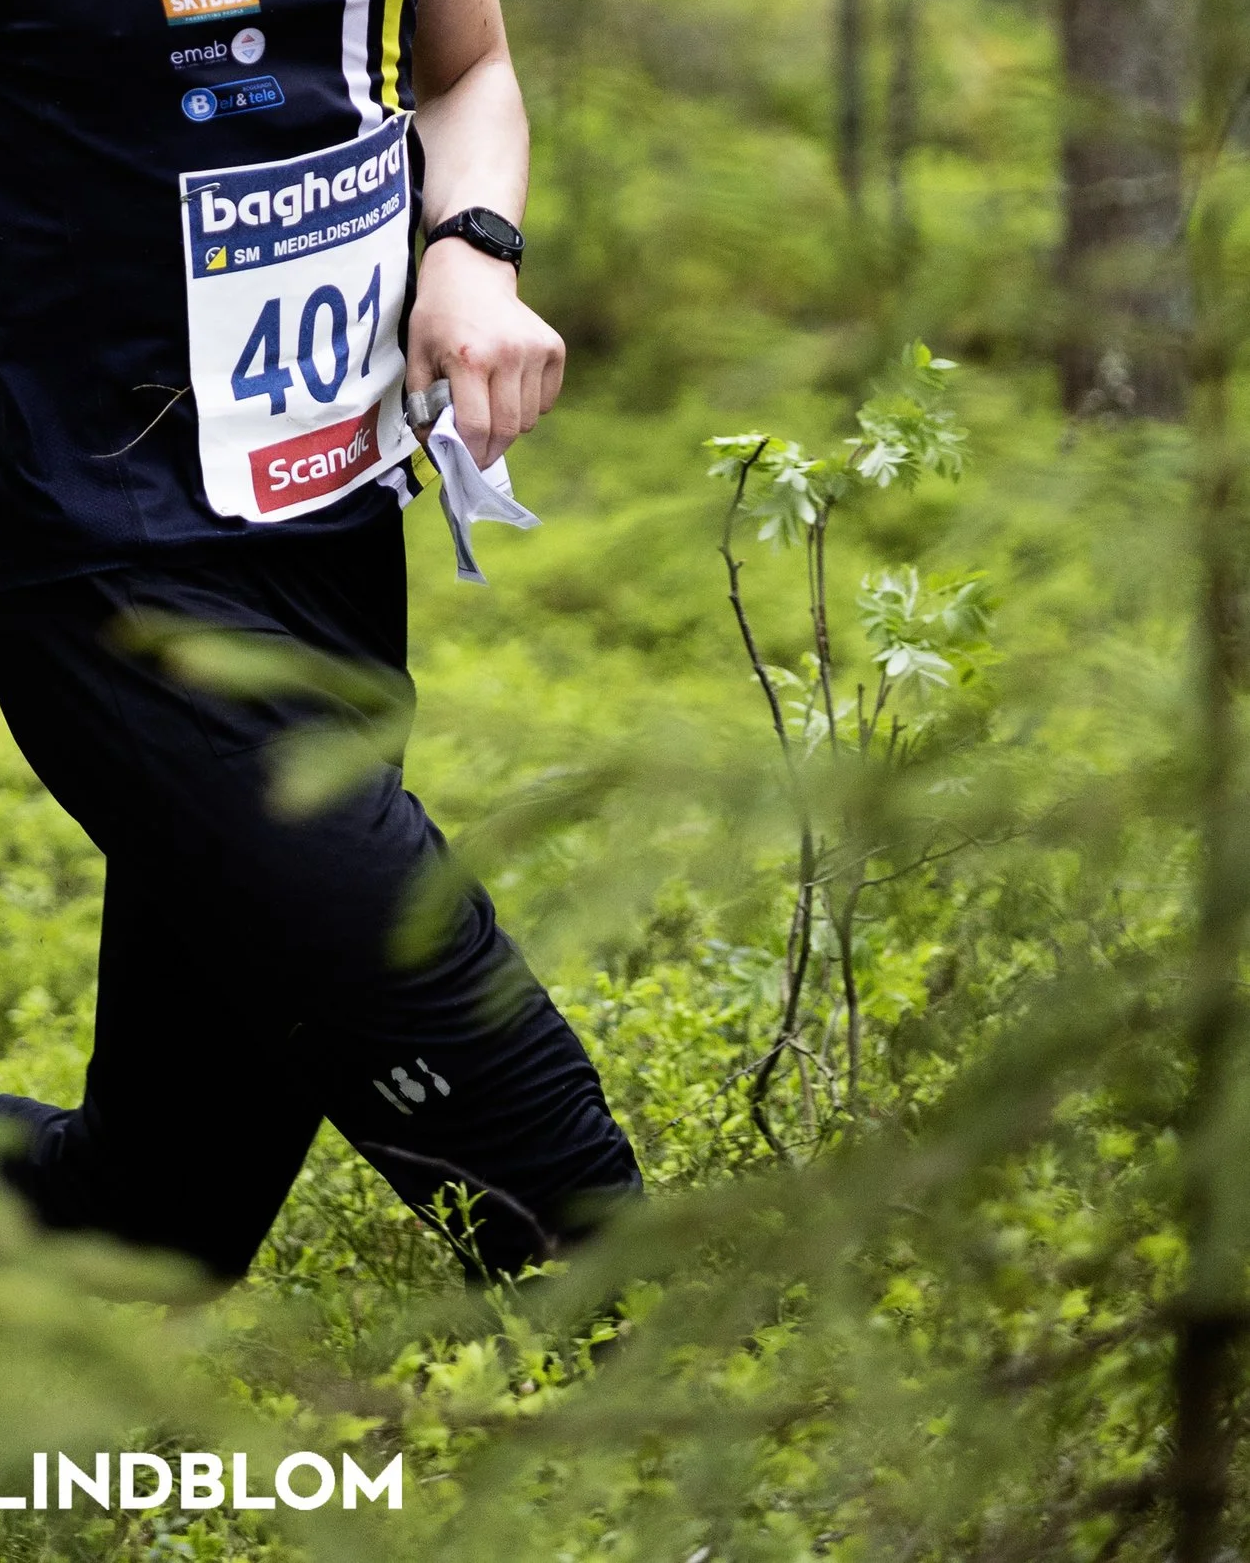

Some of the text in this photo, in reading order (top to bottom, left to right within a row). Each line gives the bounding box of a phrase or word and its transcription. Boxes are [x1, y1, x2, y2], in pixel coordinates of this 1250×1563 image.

[170, 40, 227, 64] emab
[236, 93, 247, 106] &
[249, 88, 276, 103] tele
[201, 138, 401, 233] bagheera
[234, 193, 400, 264] SM MEDELDISTANS 2025
[231, 263, 381, 416] 401
[268, 428, 370, 491] Scandic
